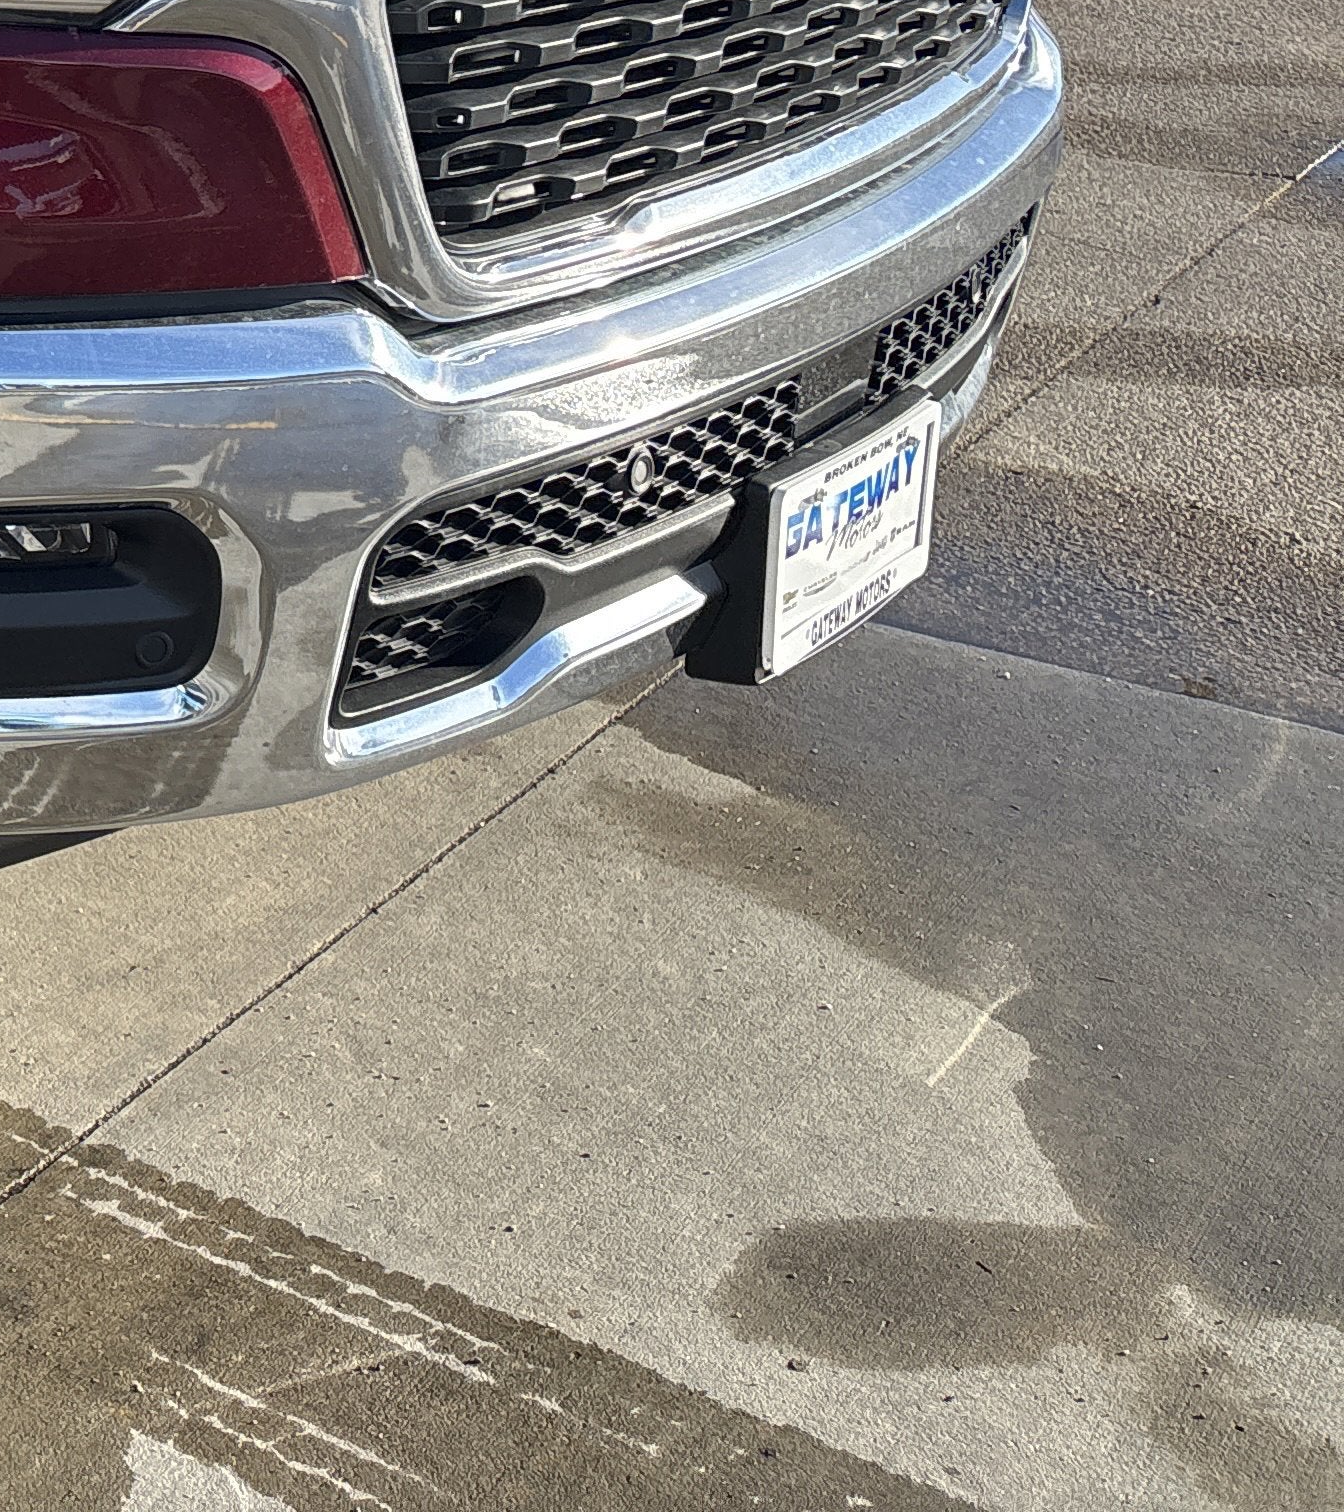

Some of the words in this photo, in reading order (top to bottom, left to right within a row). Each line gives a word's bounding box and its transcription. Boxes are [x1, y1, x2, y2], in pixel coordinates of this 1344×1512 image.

[785, 439, 921, 559] GATEWAY
[824, 451, 868, 483] BROKEN
[812, 595, 853, 646] GATEWAY
[855, 569, 891, 616] MOTORS
